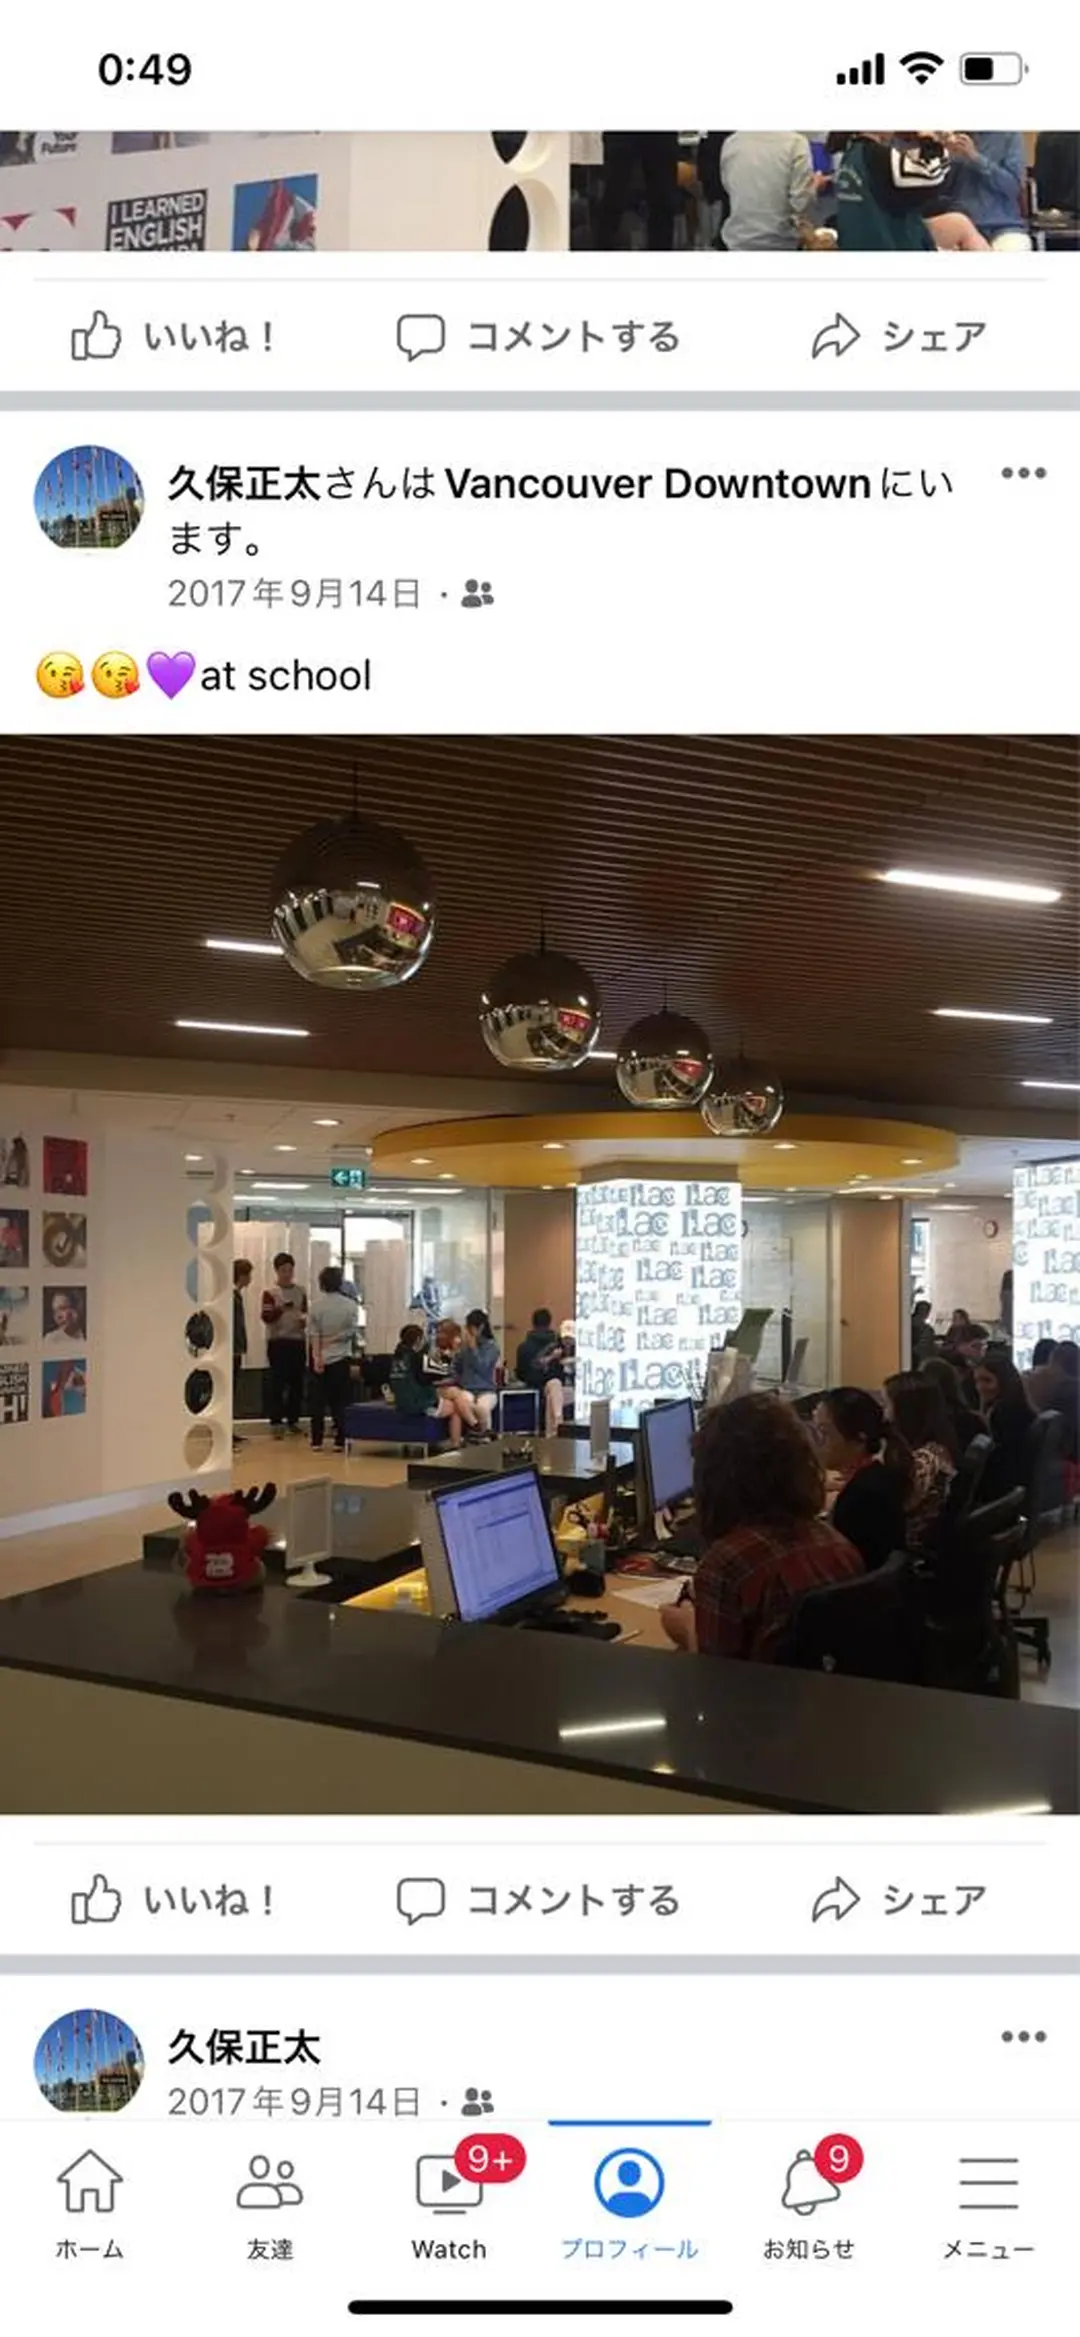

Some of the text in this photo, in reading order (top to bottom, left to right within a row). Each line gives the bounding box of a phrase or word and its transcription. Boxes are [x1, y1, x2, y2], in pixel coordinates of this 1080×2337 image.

[99, 53, 191, 86] 0:49
[110, 192, 204, 224] I LEARNED
[110, 216, 203, 249] ENGLISH
[146, 320, 270, 352] いいね！
[470, 320, 678, 352] コメントする
[885, 322, 985, 351] シェア
[168, 465, 952, 502] 久保正太さんは Vancouver Downtown にい
[172, 522, 258, 556] ます。
[169, 578, 418, 608] 2017年9月14日
[201, 658, 370, 691] at school
[146, 1884, 270, 1916] いいね！
[471, 1884, 678, 1916] コメントする
[885, 1886, 985, 1915] シェア
[169, 2028, 321, 2065] 久保正太
[169, 2087, 418, 2116] 2017年9月14日
[468, 2145, 512, 2173] 9+
[829, 2145, 850, 2173] 9
[57, 2239, 123, 2260] ホーム
[248, 2238, 293, 2260] 友達
[412, 2239, 486, 2260] Watch
[565, 2238, 697, 2259] プロフィール
[764, 2238, 854, 2260] お知らせ
[945, 2239, 1033, 2260] メニュー
